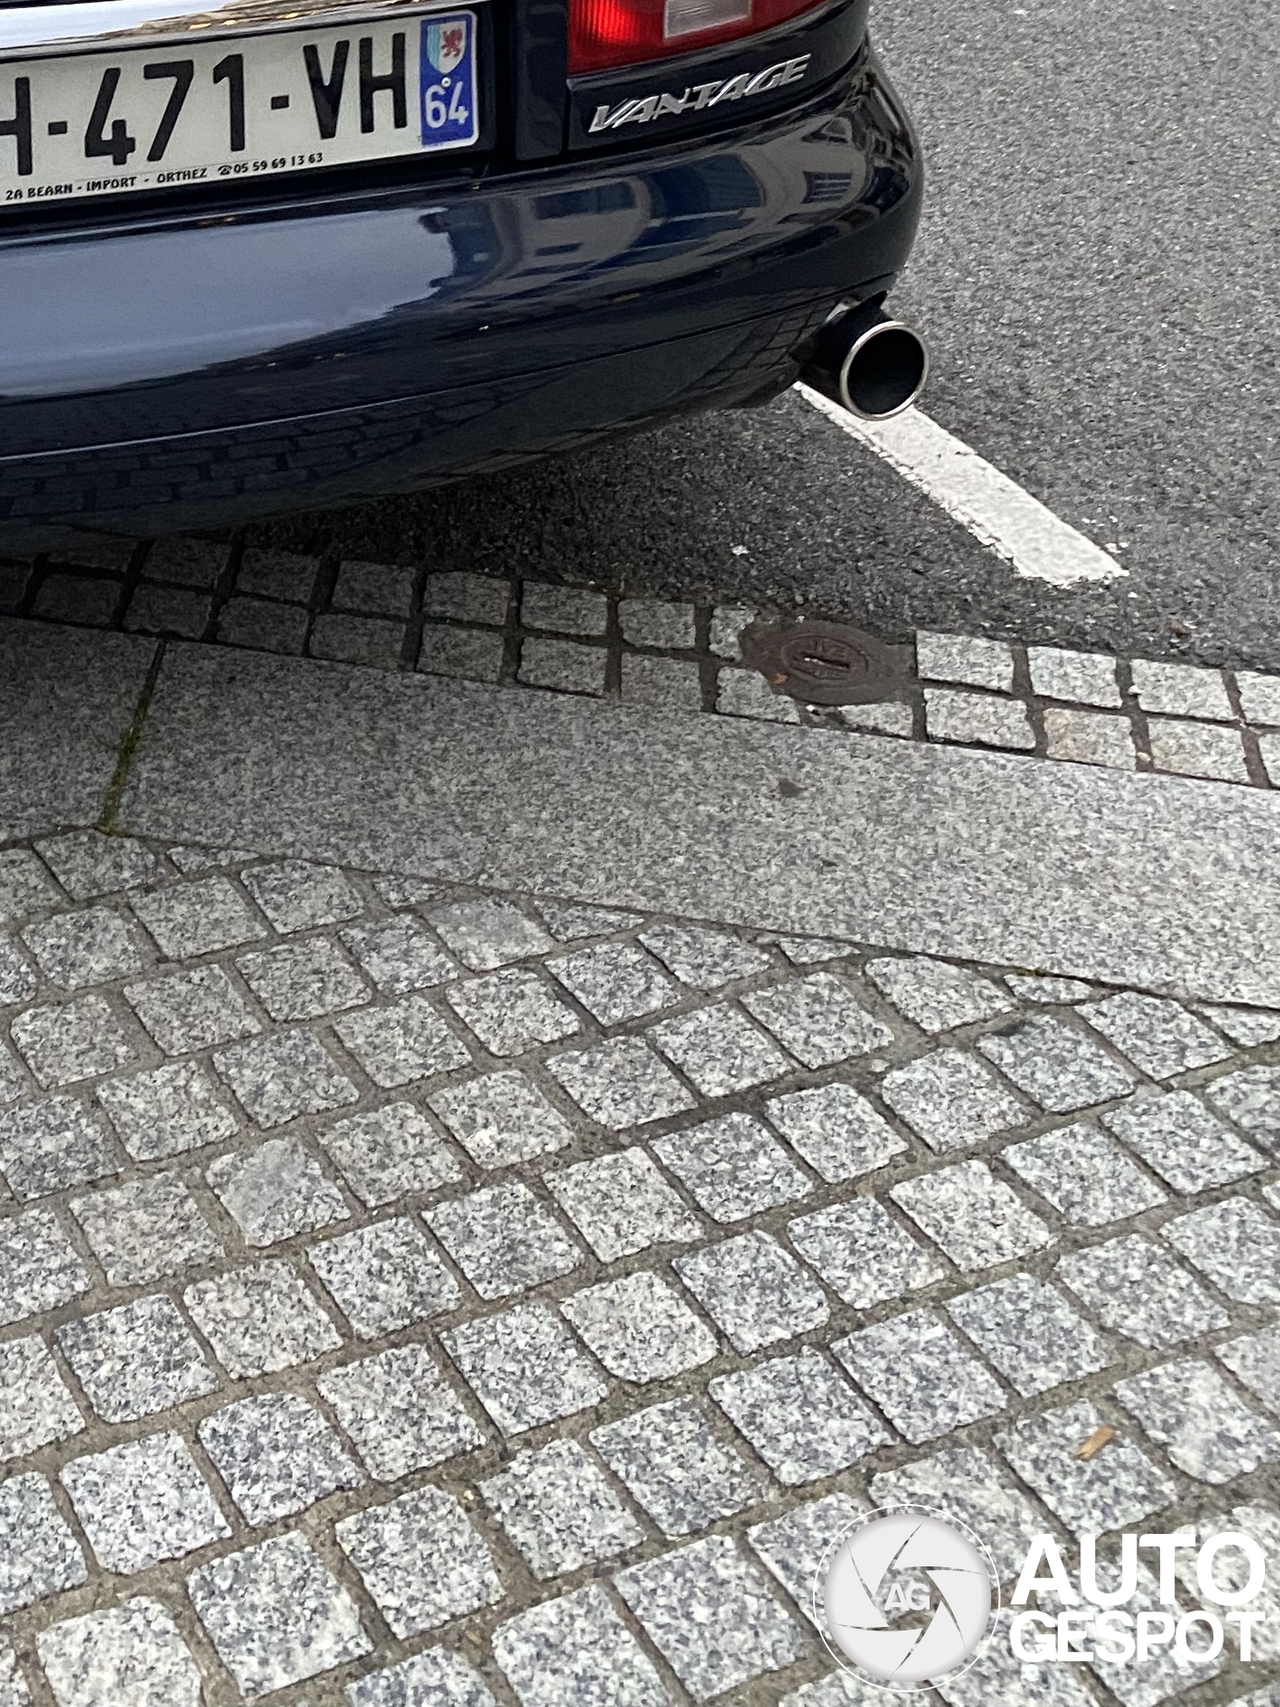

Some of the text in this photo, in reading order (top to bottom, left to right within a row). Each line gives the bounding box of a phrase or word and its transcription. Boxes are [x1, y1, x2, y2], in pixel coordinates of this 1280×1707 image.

[425, 81, 469, 128] 64
[588, 53, 812, 133] VANTAGE
[5, 189, 23, 201] 2A
[27, 183, 74, 197] BEARN
[86, 176, 137, 192] IMPORT
[156, 168, 208, 184] ORTHEZ
[252, 159, 268, 172] 59
[271, 157, 287, 169] 69
[290, 154, 305, 167] 13
[308, 152, 324, 164] 63
